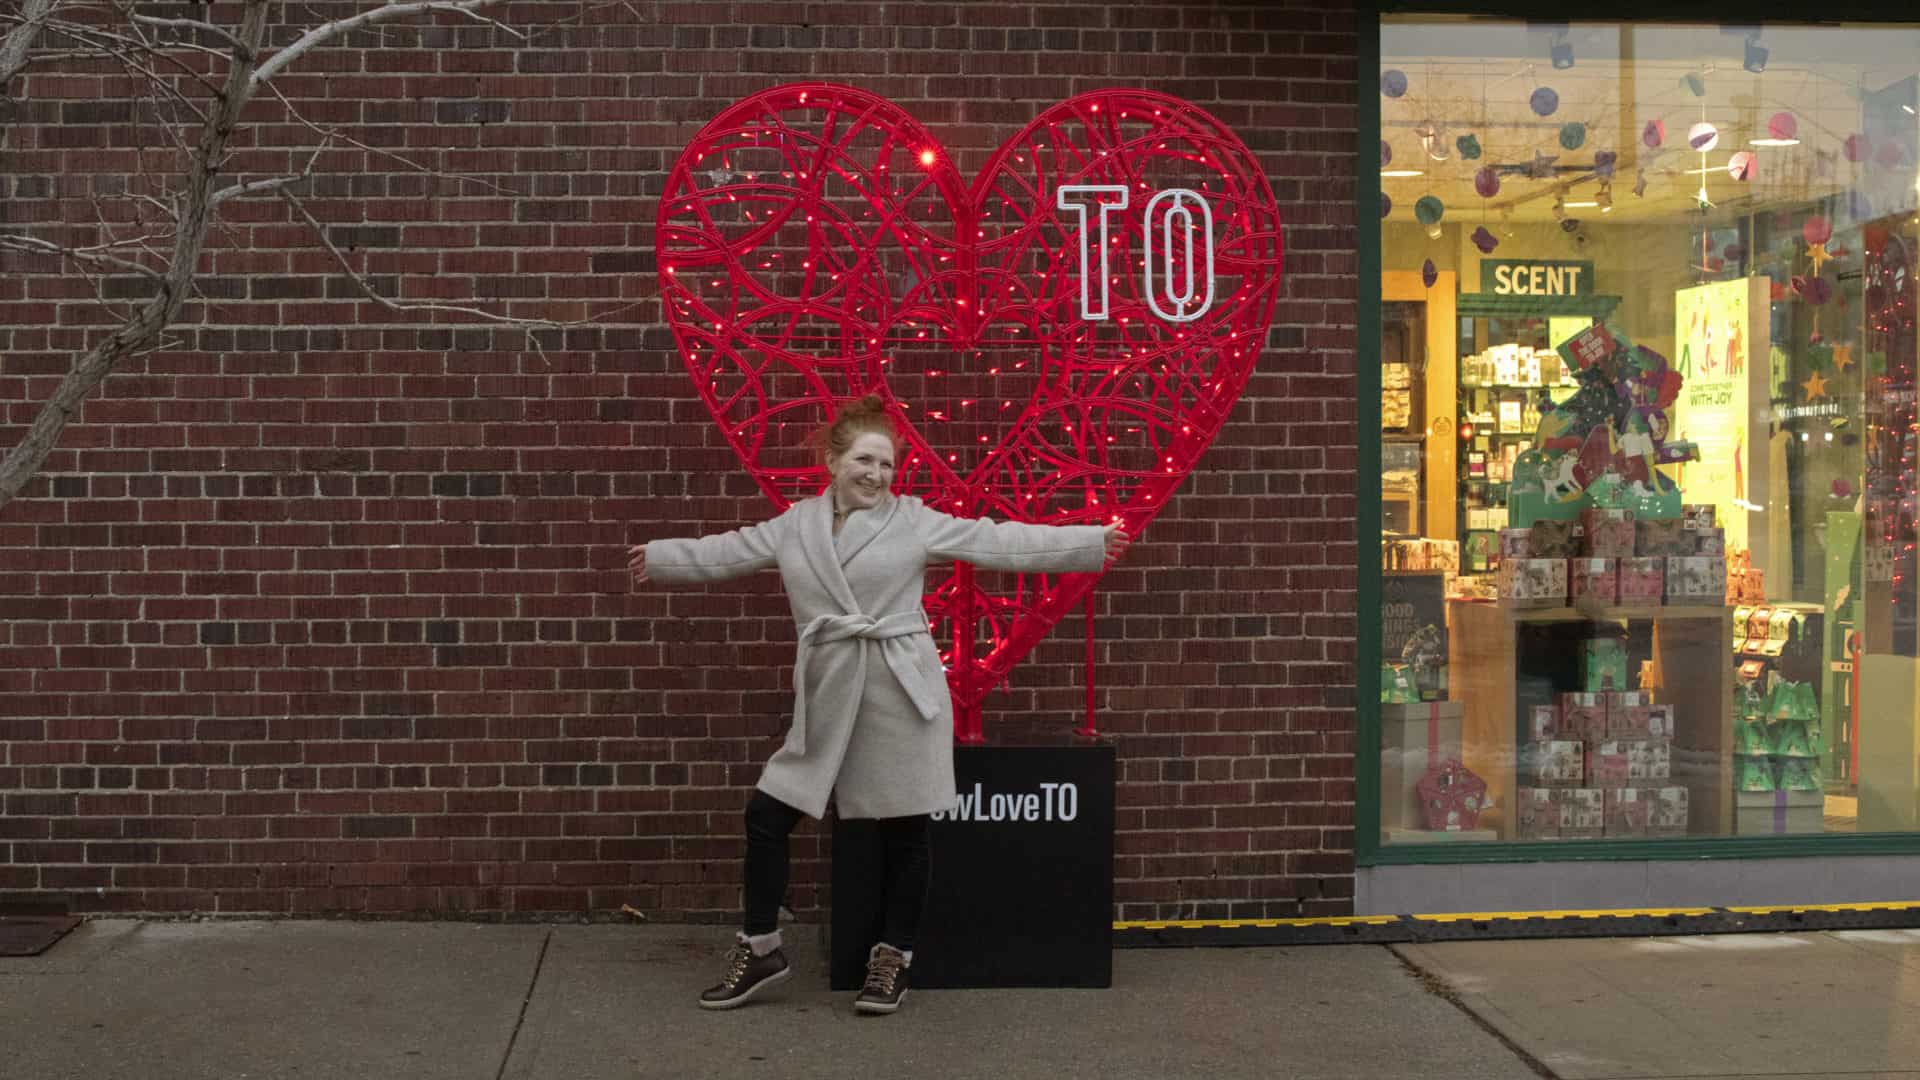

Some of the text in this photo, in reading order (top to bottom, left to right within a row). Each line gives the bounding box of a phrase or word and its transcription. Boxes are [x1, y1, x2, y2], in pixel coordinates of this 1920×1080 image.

[1057, 184, 1214, 322] TO
[1494, 265, 1582, 296] SCENT
[1690, 391, 1733, 406] WITH JOY
